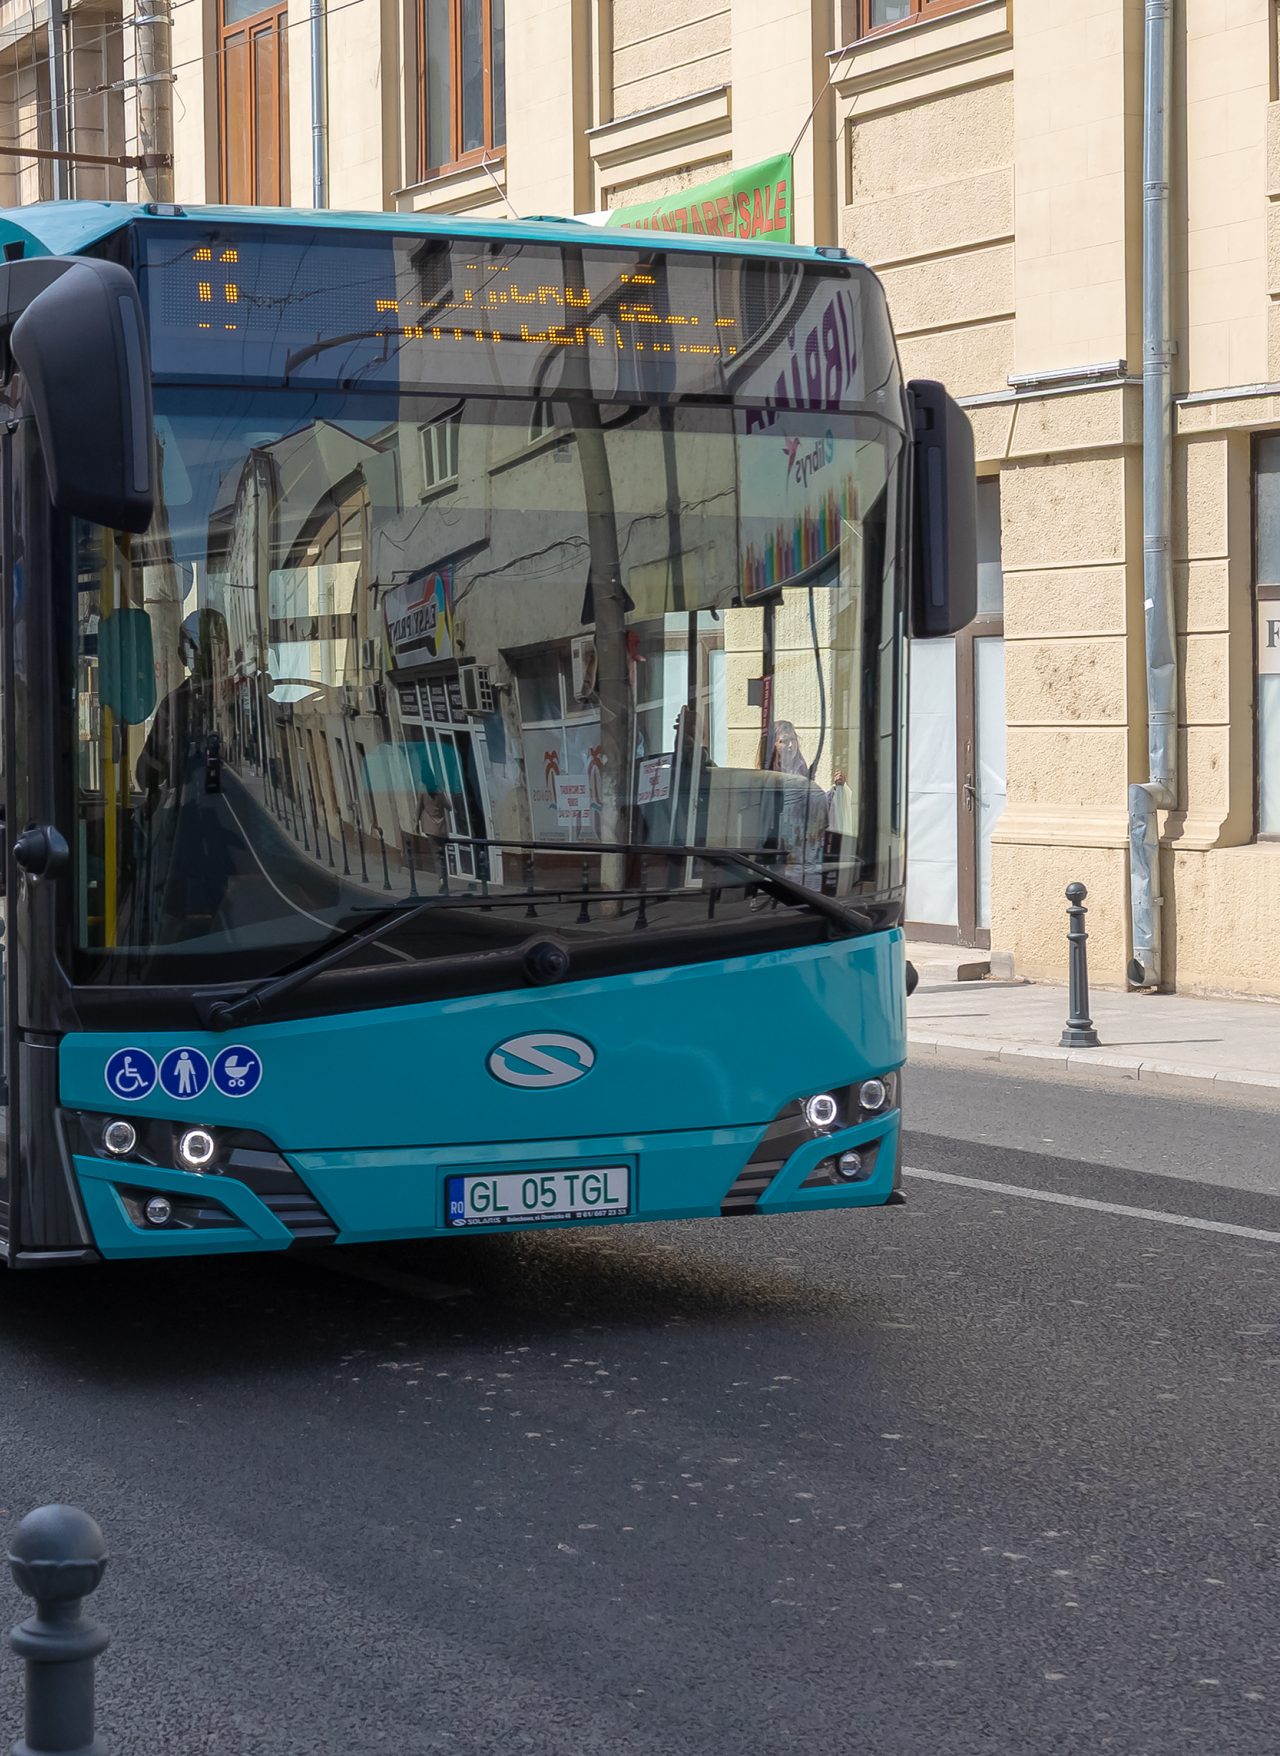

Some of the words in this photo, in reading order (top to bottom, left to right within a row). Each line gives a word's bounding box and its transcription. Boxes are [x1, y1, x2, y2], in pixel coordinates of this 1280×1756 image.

[470, 1181, 509, 1212] GL
[522, 1176, 557, 1209] 05
[564, 1173, 619, 1206] TGL
[450, 1200, 464, 1214] RO
[467, 1216, 501, 1225] SOLARIS
